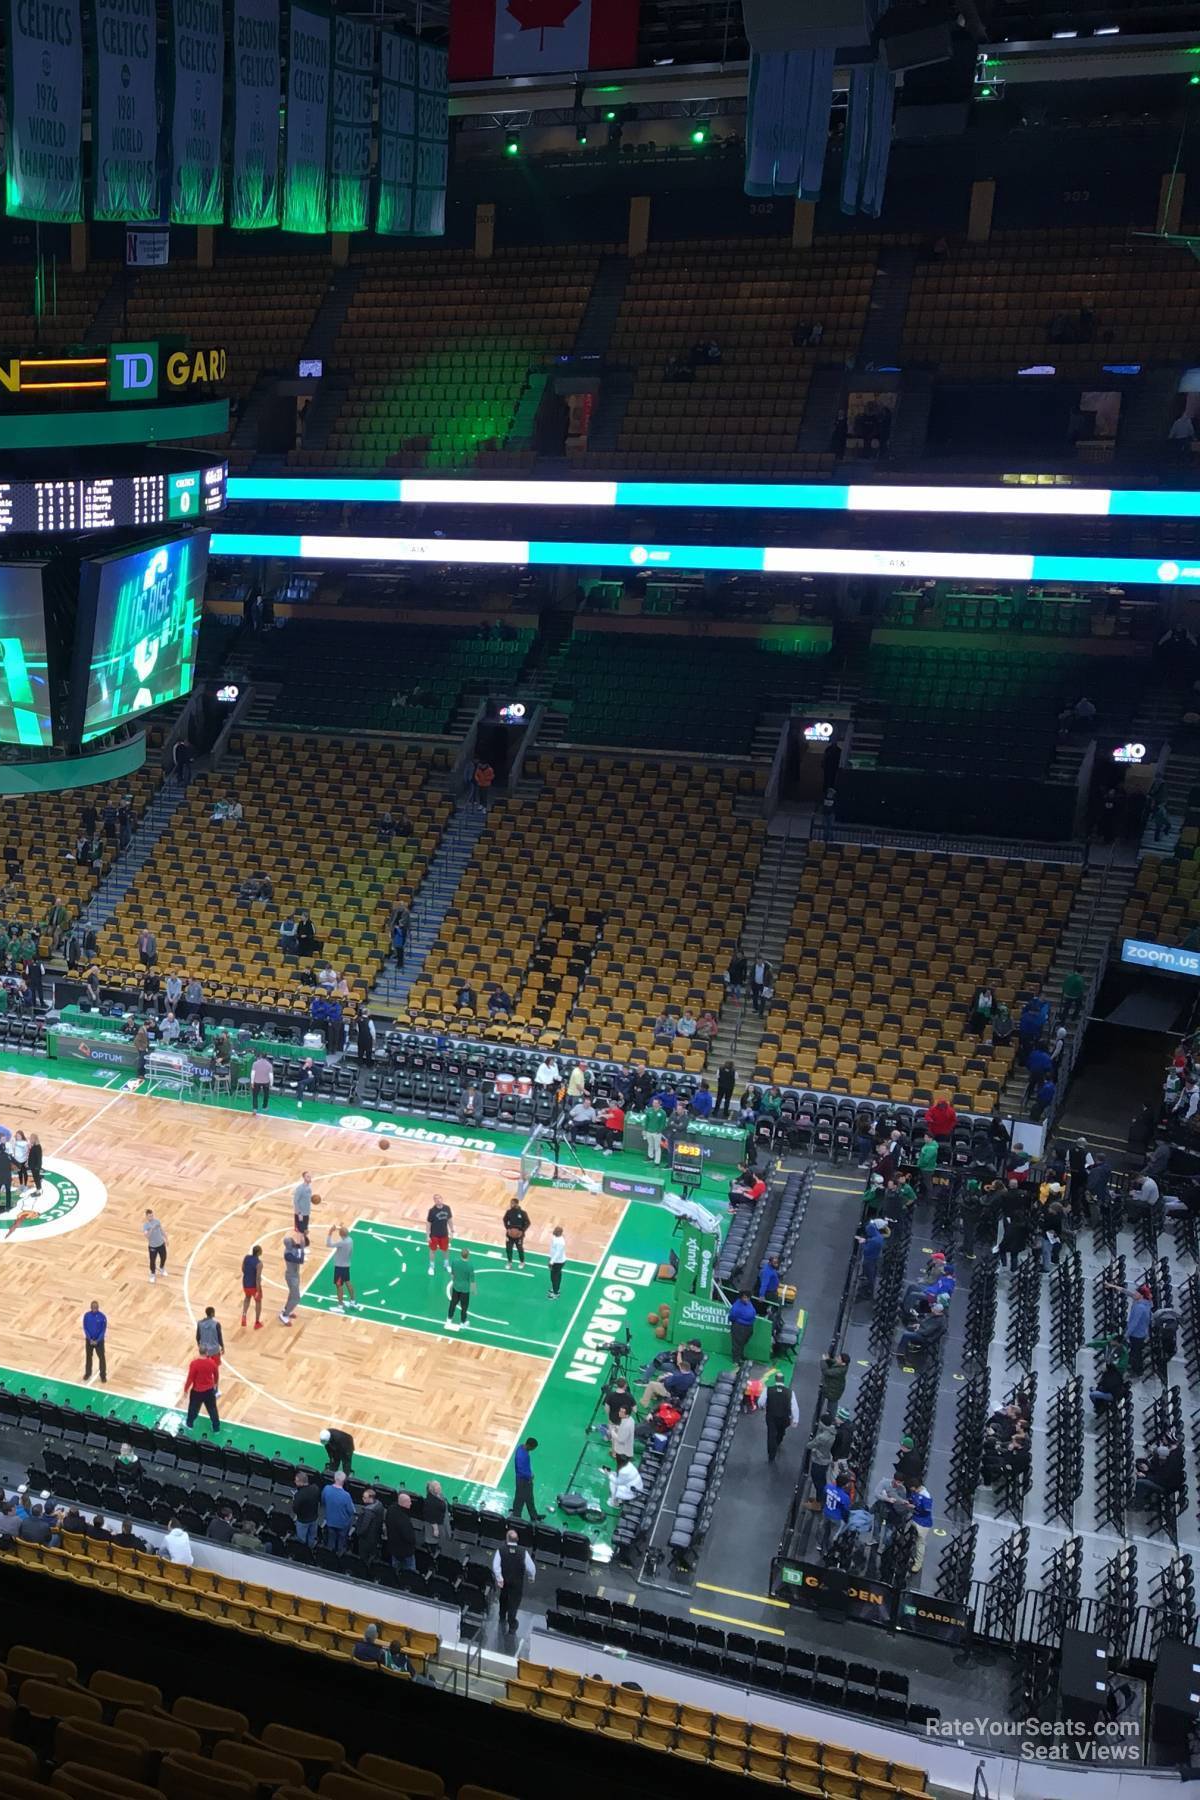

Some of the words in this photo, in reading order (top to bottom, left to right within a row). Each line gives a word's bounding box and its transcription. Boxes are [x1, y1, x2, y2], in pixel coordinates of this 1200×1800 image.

[17, 0, 73, 47] CELTICS
[102, 17, 149, 58] CELTICS
[238, 16, 276, 49] BOSTON
[179, 35, 217, 74] CELTICS
[294, 30, 326, 68] BOSTON
[337, 21, 352, 64] 22
[240, 54, 275, 87] CELTICS
[294, 69, 325, 104] CELTICS
[117, 95, 135, 121] 1981
[29, 116, 66, 148] WORLD
[112, 127, 143, 152] WORLD
[128, 234, 138, 261] N
[116, 353, 153, 389] TD
[181, 492, 190, 512] 0
[150, 573, 172, 620] RISE
[224, 685, 239, 698] 10
[510, 703, 526, 717] 10
[814, 722, 833, 737] 10
[1125, 743, 1146, 758] 10
[1127, 945, 1198, 969] zoom.us
[91, 1050, 122, 1063] OPTUM
[375, 1122, 496, 1151] Putnam
[688, 1121, 745, 1138] xfinity
[678, 1144, 701, 1157] 66:33
[39, 1181, 77, 1222] CELTICS
[684, 1237, 698, 1273] xfinity
[618, 1263, 646, 1281] TD
[700, 1258, 710, 1288] Putnam
[691, 1300, 727, 1316] Boston
[565, 1284, 636, 1385] GARDEN
[934, 1528, 947, 1537] C
[918, 1610, 967, 1628] GARDEN
